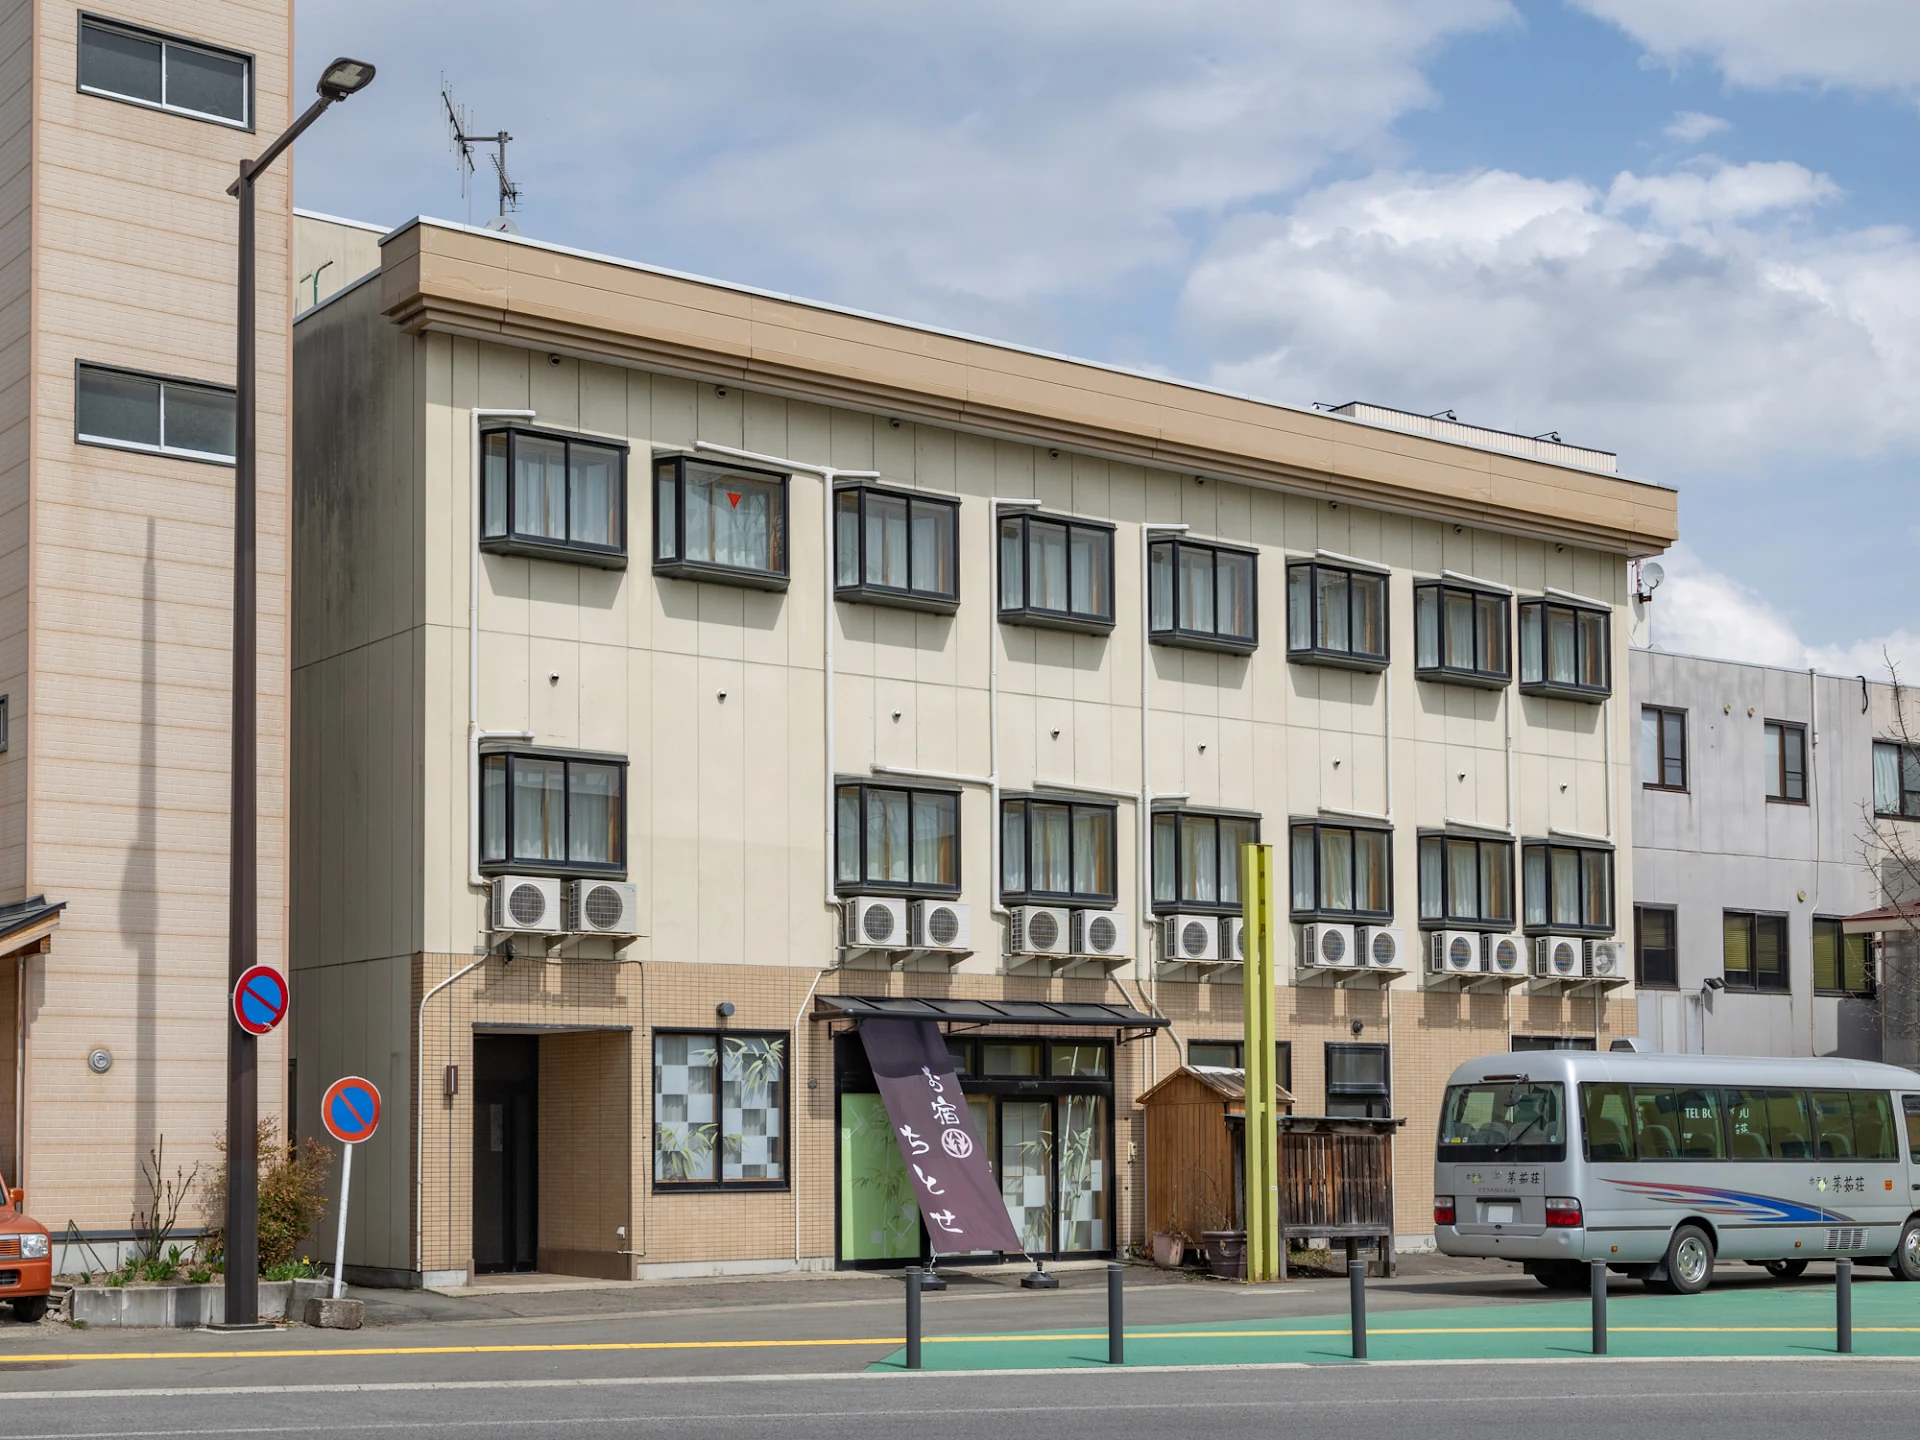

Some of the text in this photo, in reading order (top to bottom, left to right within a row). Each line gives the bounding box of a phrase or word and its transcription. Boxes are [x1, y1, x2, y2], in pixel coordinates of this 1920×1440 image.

[920, 1065, 960, 1126] お宿
[899, 1124, 963, 1235] ちとせ
